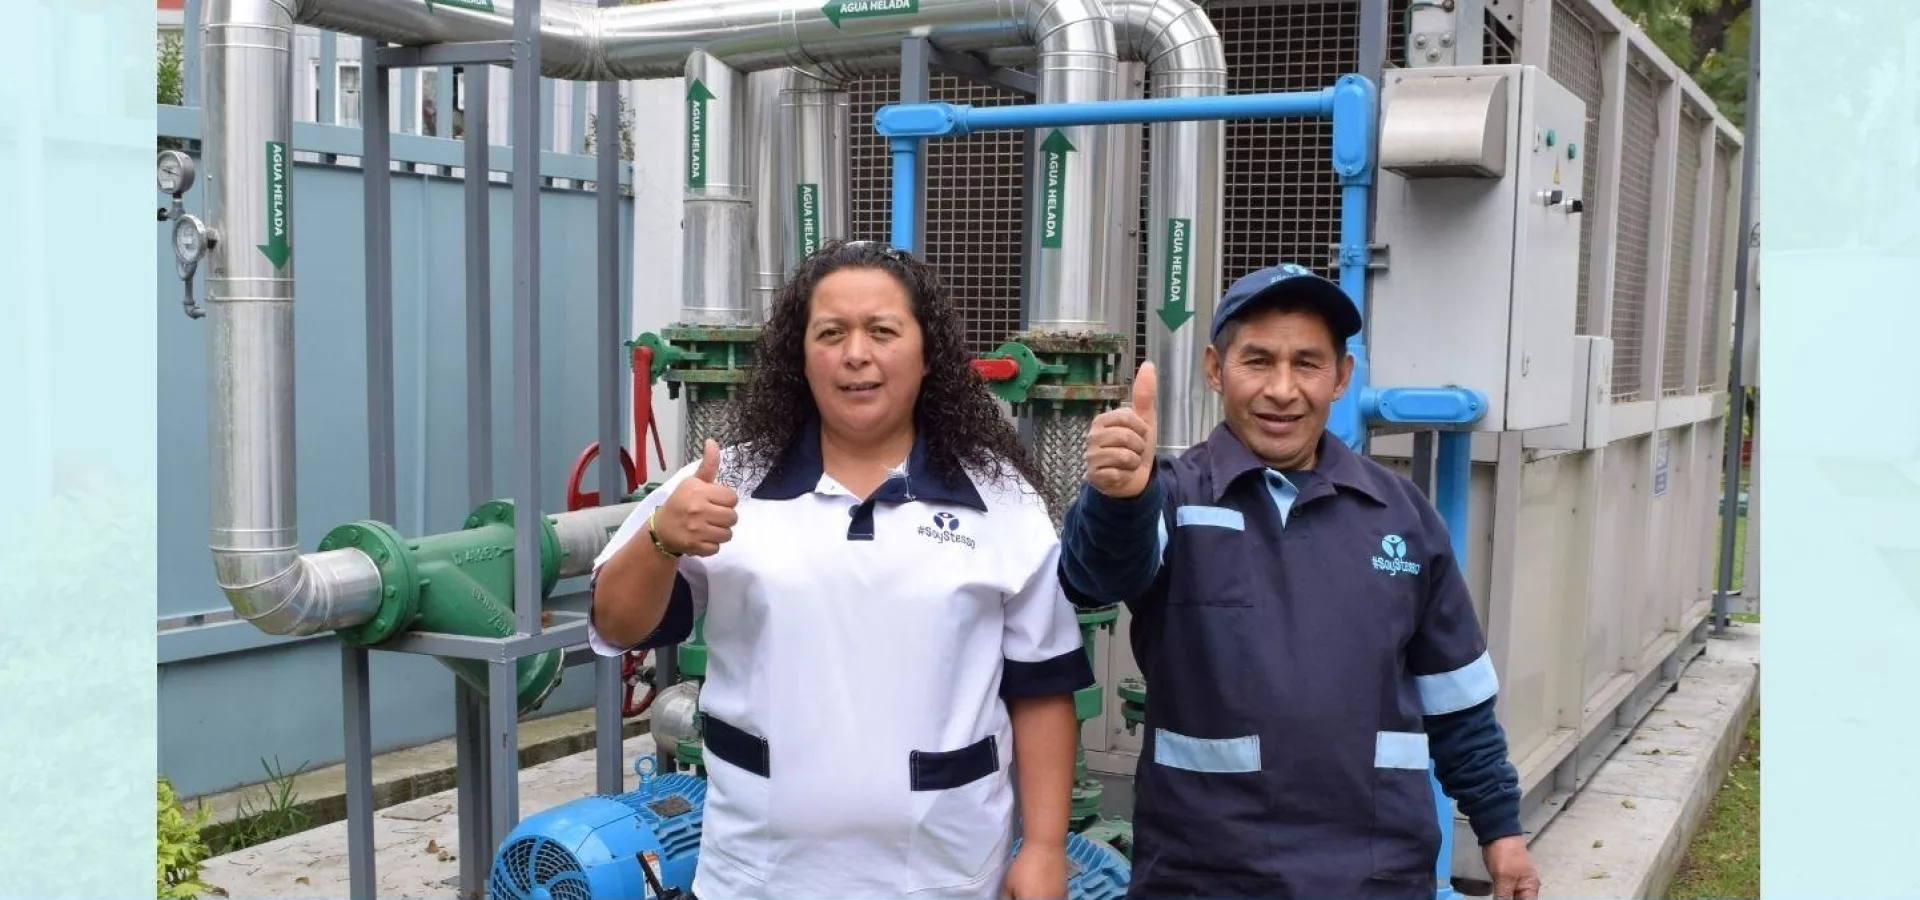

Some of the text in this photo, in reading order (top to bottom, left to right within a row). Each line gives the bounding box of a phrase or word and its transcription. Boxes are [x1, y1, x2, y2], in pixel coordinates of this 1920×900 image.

[840, 0, 910, 13] AGUA HELADA
[691, 100, 701, 178] AGUA HELADA
[272, 143, 284, 236] AGUA HELADA
[803, 185, 813, 217] AGUA
[1045, 152, 1060, 238] AGUA HELADA
[1169, 220, 1185, 302] AGUA HELADA
